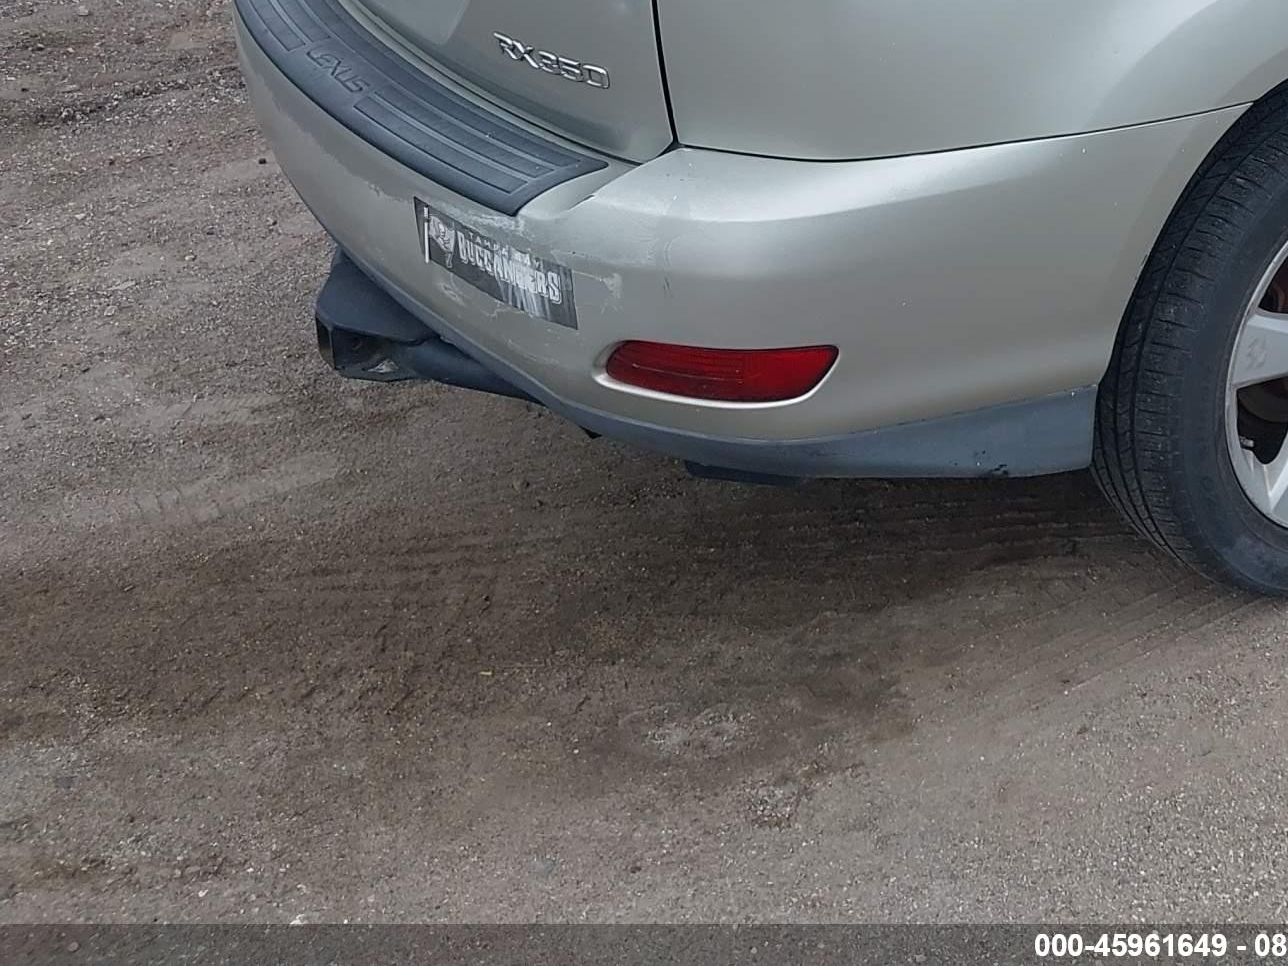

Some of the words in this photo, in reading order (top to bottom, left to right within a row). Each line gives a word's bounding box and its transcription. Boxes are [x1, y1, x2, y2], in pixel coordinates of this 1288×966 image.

[306, 49, 372, 94] LEXUS
[492, 31, 611, 89] RX350
[467, 229, 509, 257] TAMPA
